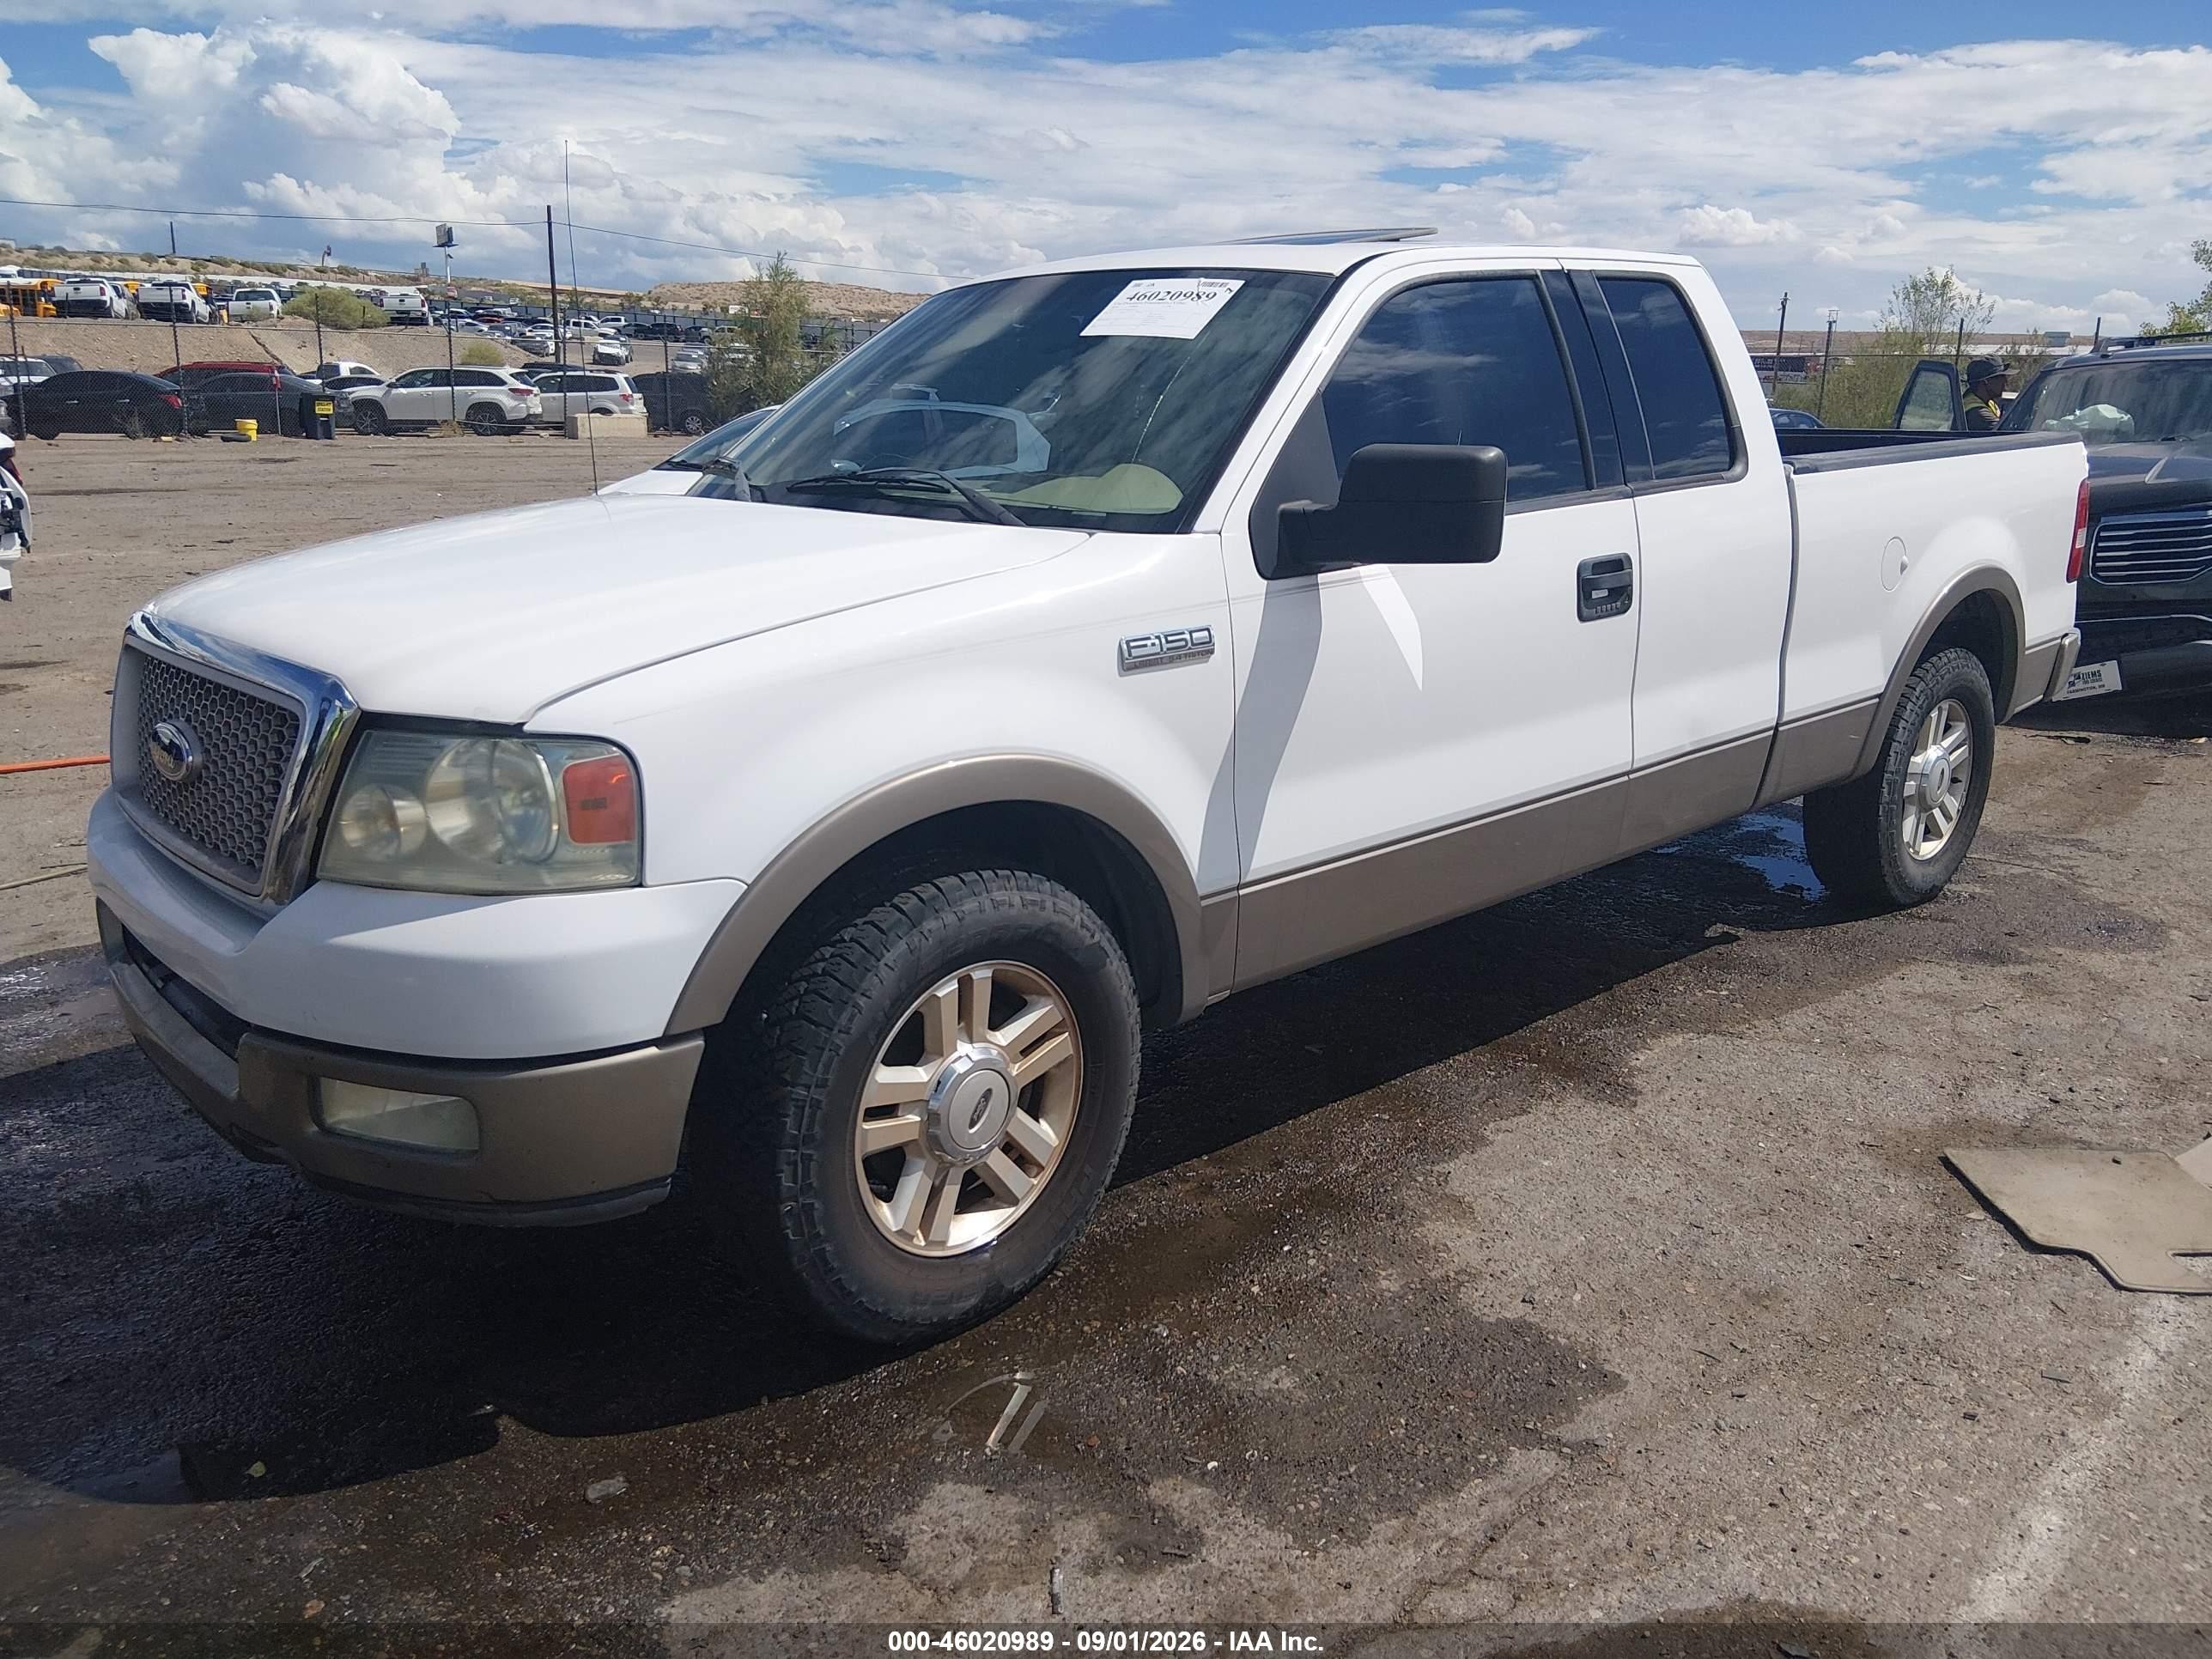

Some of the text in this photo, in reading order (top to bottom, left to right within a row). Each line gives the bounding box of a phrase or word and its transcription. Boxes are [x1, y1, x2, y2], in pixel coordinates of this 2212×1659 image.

[1127, 290, 1218, 302] 46020989
[1124, 626, 1214, 659] F-150
[2081, 670, 2102, 680] ZIEMS
